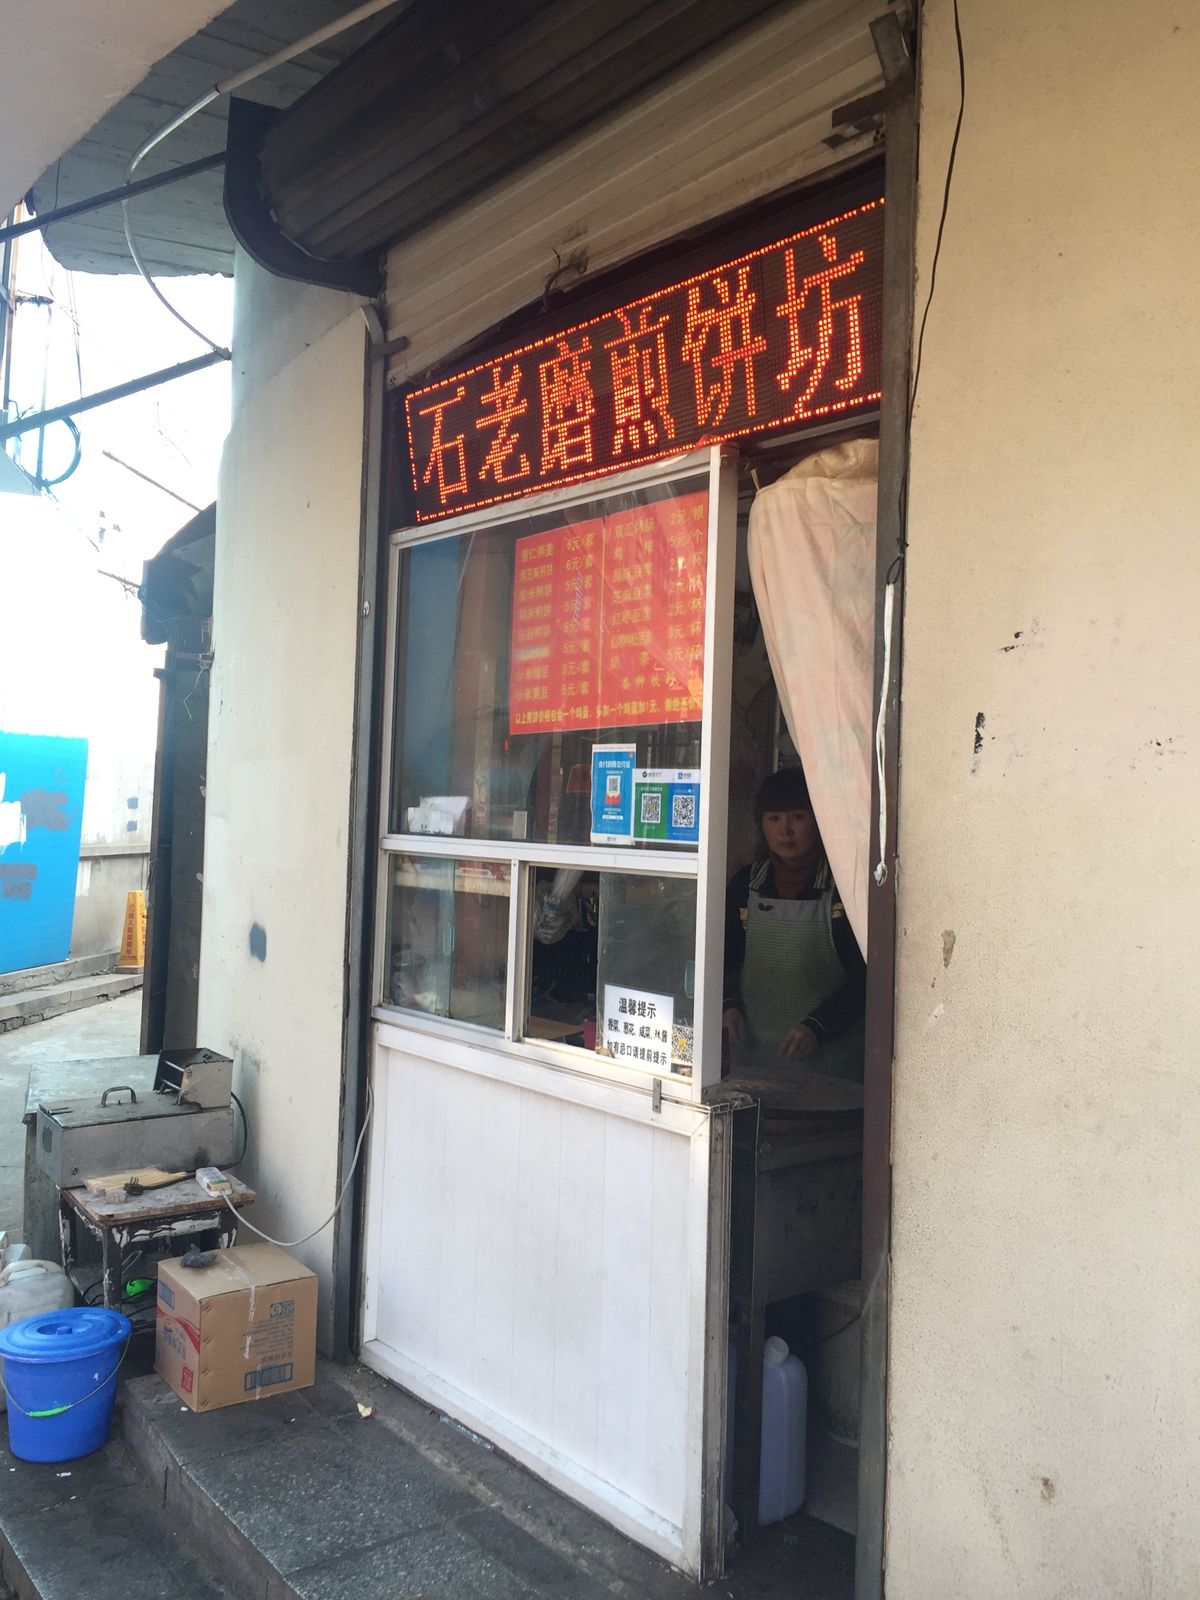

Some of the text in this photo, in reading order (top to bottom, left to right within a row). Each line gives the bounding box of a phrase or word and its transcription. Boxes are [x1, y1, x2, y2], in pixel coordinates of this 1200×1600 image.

[671, 504, 704, 525] 2元/根
[567, 532, 594, 550] 6元/套
[670, 528, 704, 548] 5元/个
[566, 554, 593, 571] 6元/套
[562, 660, 590, 676] 5元/套
[562, 681, 590, 697] 5元/套
[618, 997, 656, 1019] 温馨提示
